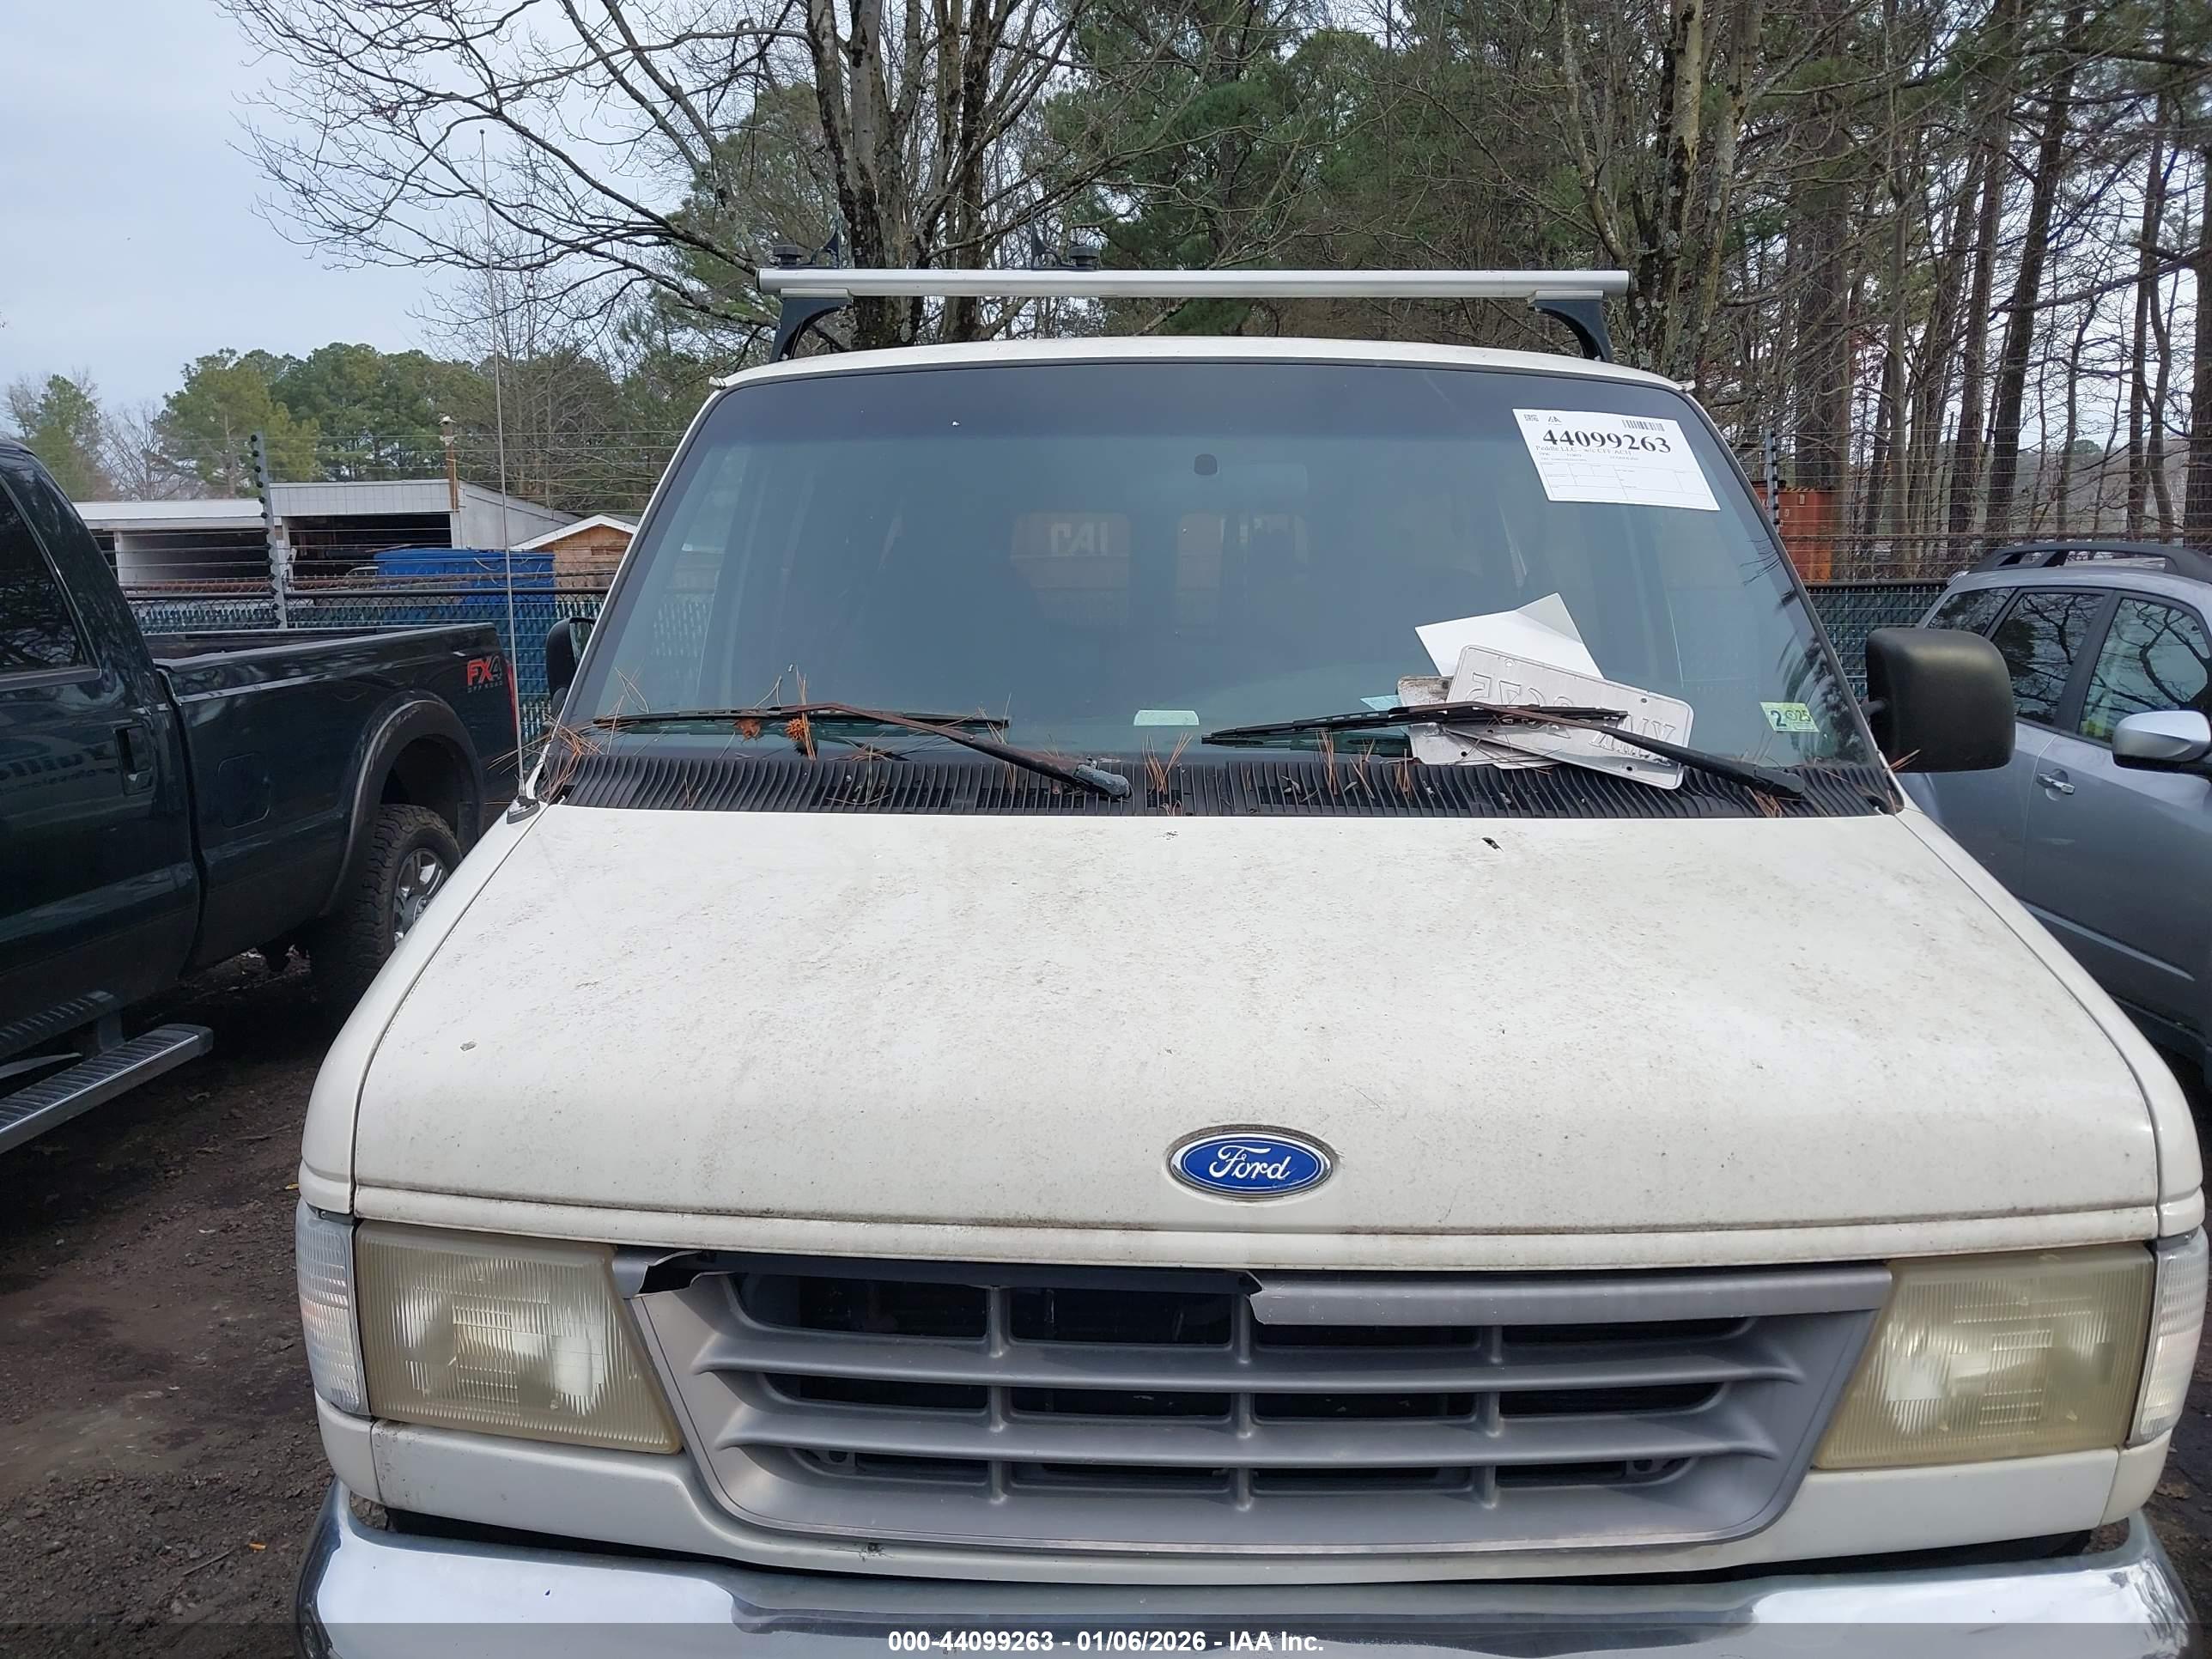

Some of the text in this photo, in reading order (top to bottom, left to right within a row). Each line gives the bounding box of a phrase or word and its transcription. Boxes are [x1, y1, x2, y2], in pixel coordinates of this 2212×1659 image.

[1543, 429, 1671, 454] 44099263
[467, 655, 502, 686] FX4
[1770, 709, 1787, 727] 2
[1207, 1145, 1291, 1180] Ford
